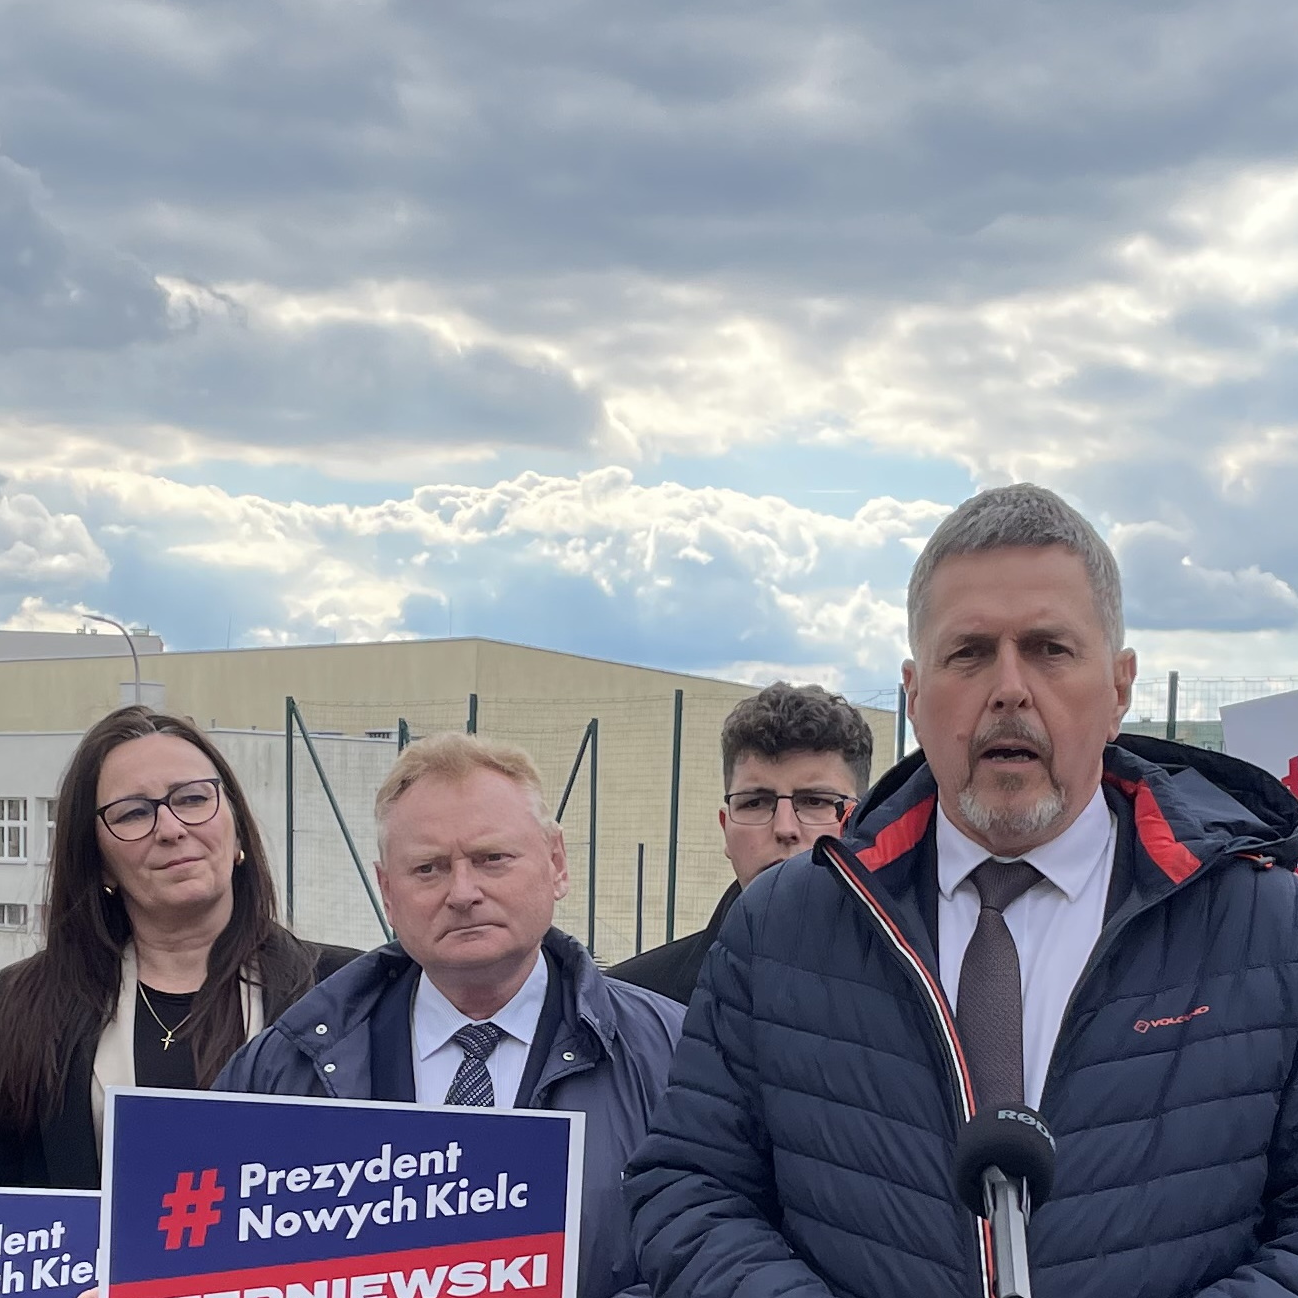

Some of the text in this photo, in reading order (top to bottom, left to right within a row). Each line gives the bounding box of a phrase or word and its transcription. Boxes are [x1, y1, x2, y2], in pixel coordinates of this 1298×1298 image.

[240, 1141, 462, 1198] Prezydent
[158, 1169, 225, 1250] #
[238, 1172, 528, 1242] Nowych Kielc
[32, 1249, 100, 1289] Kie
